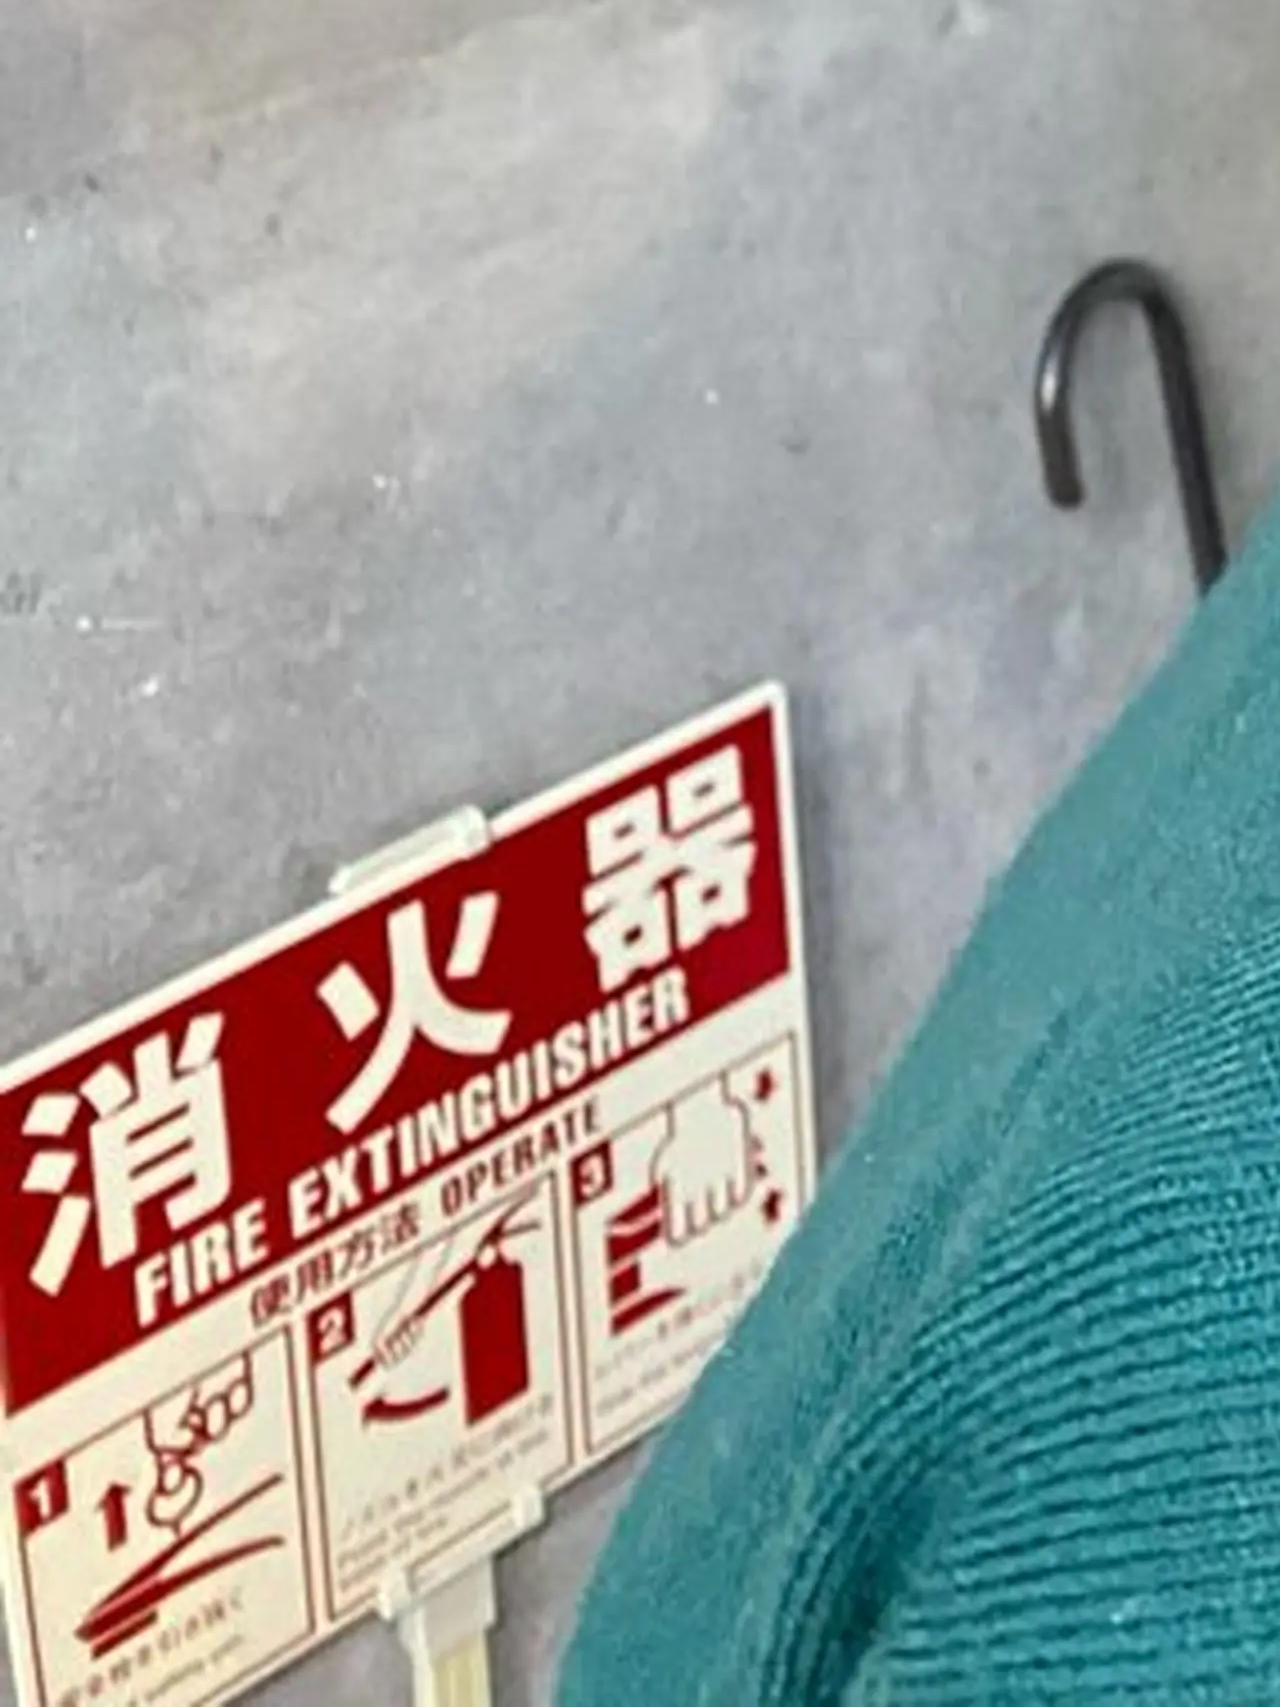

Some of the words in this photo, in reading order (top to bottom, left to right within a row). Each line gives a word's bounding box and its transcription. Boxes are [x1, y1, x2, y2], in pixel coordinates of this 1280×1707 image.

[21, 743, 760, 1297] 消火器
[134, 1197, 270, 1330] FIRE
[288, 967, 691, 1241] EXTINGUISHER
[439, 1097, 601, 1217] OPERATE
[578, 1154, 608, 1199] 3
[250, 1199, 421, 1327] 使用方法
[317, 1307, 349, 1349] 2
[30, 1483, 53, 1517] 1
